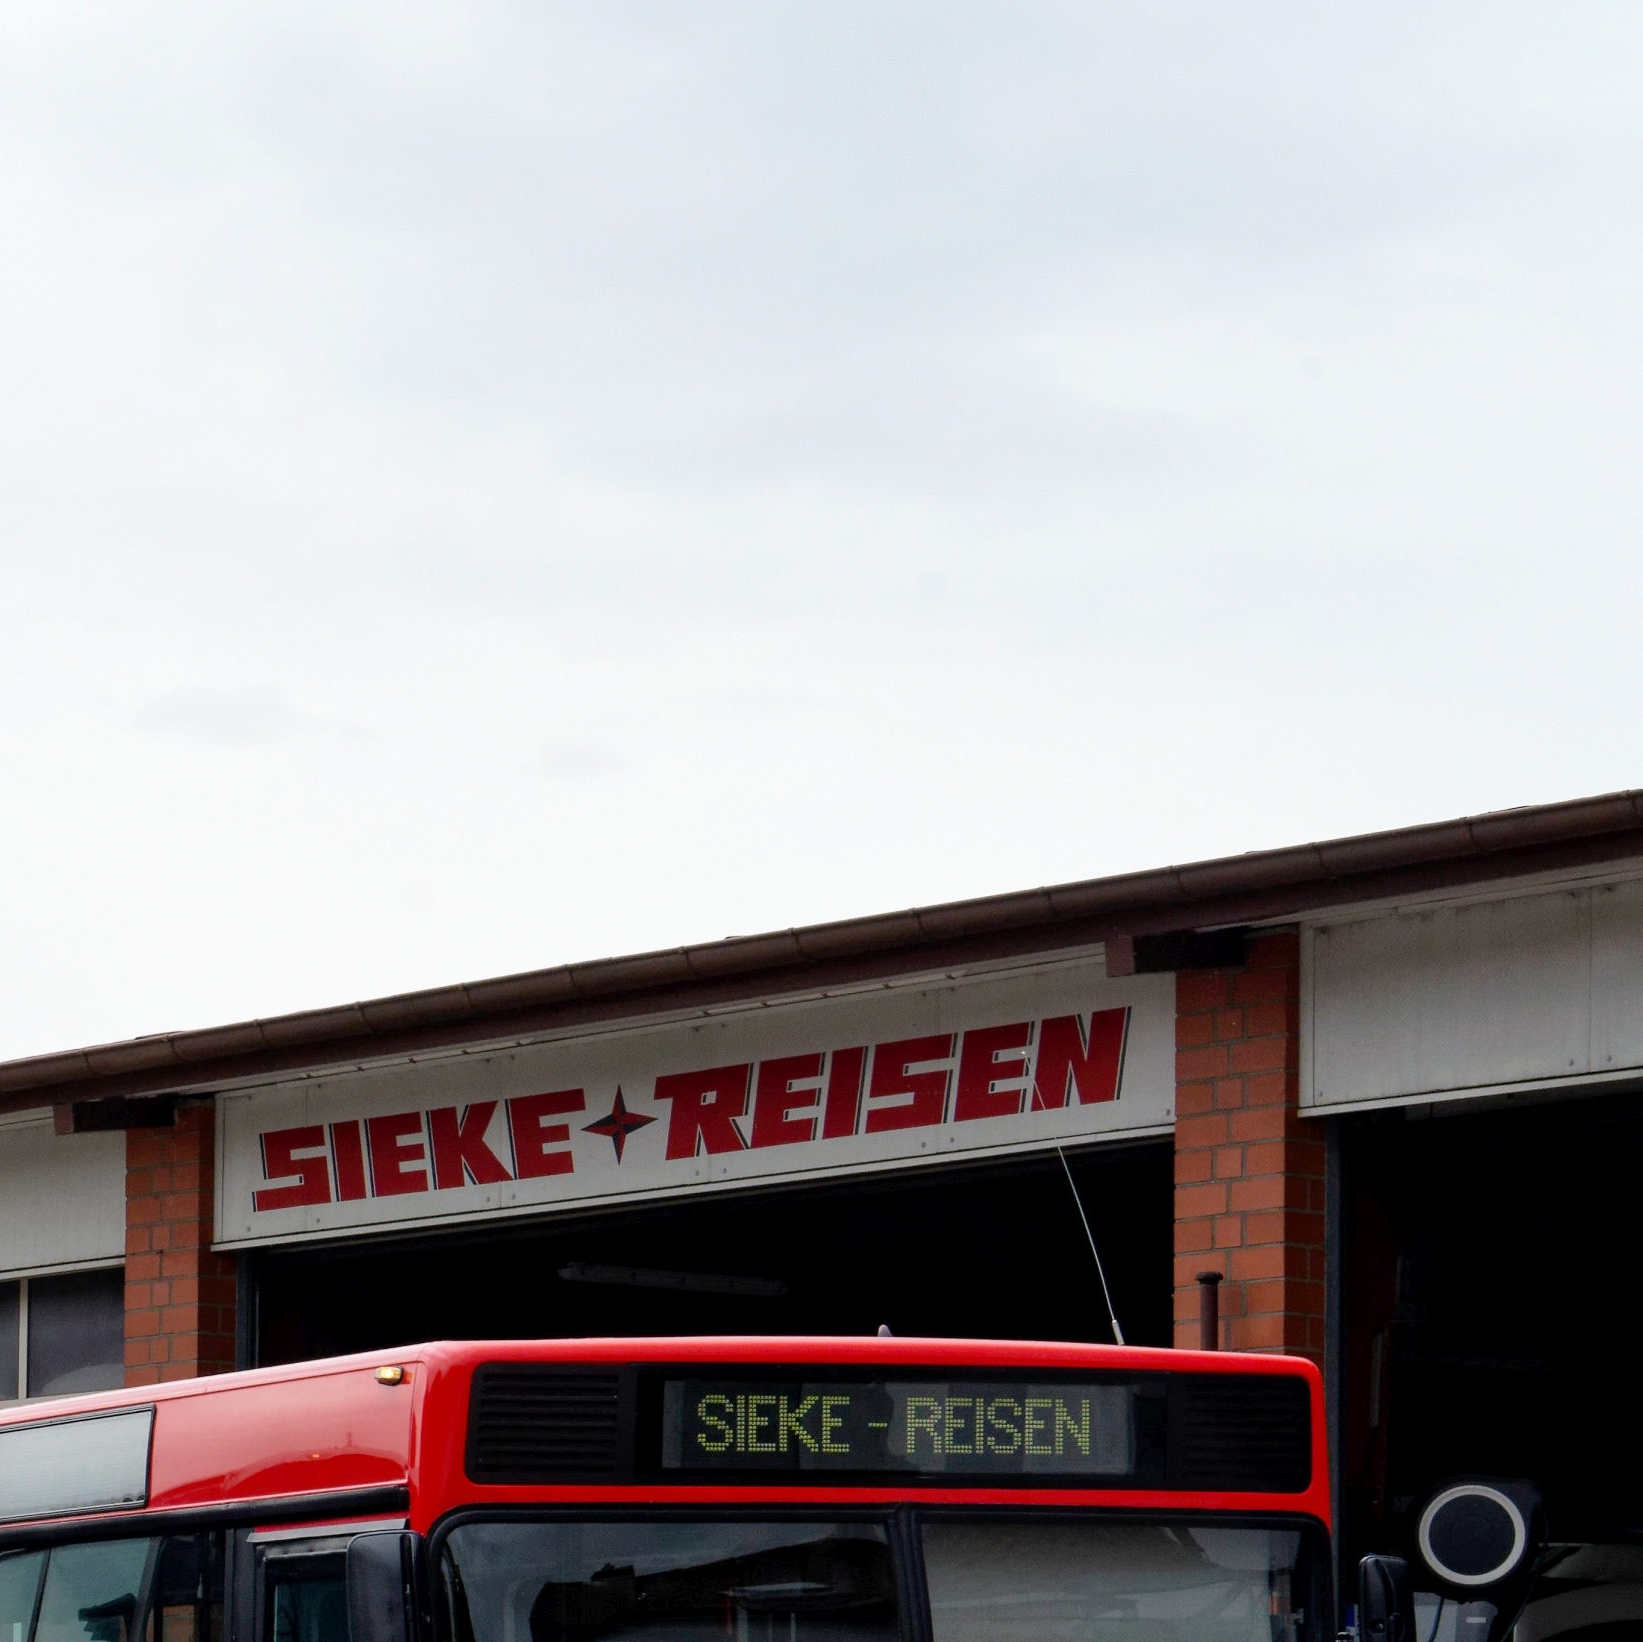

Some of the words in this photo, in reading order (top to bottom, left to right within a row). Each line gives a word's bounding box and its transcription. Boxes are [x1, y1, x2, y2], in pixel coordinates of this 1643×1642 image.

[253, 1088, 586, 1212] SIEKE
[654, 1006, 1131, 1160] REISEN
[697, 1395, 850, 1453] SIEKE
[907, 1397, 1090, 1455] REISEN
